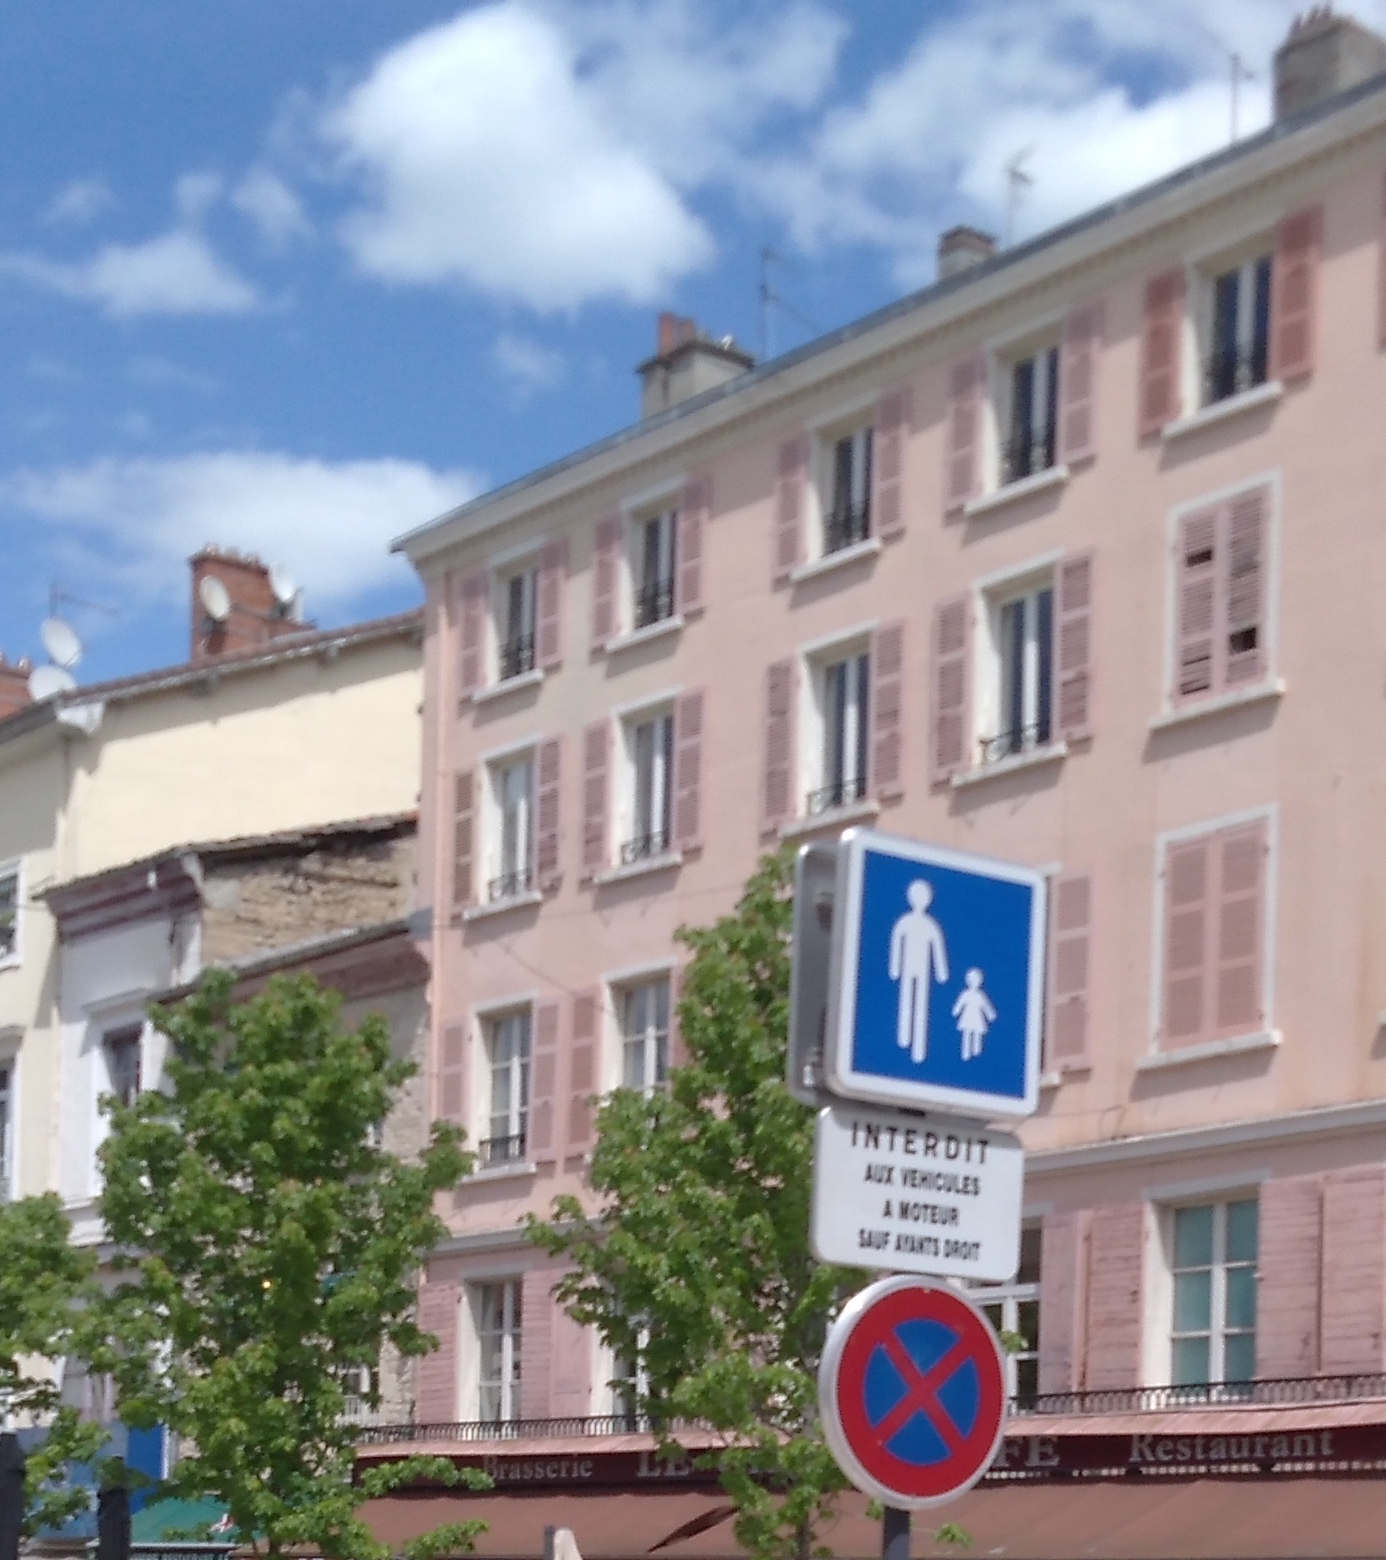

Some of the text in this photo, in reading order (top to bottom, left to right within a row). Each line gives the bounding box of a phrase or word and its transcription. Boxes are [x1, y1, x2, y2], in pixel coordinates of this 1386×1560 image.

[850, 1121, 989, 1164] INTERDIT
[864, 1162, 981, 1196] AUX VEHICULES
[883, 1199, 959, 1226] A MOTEUR
[859, 1228, 980, 1261] SAUF AYANTS DROIT
[1128, 1431, 1336, 1463] Restaurant
[483, 1454, 594, 1480] Brasserie
